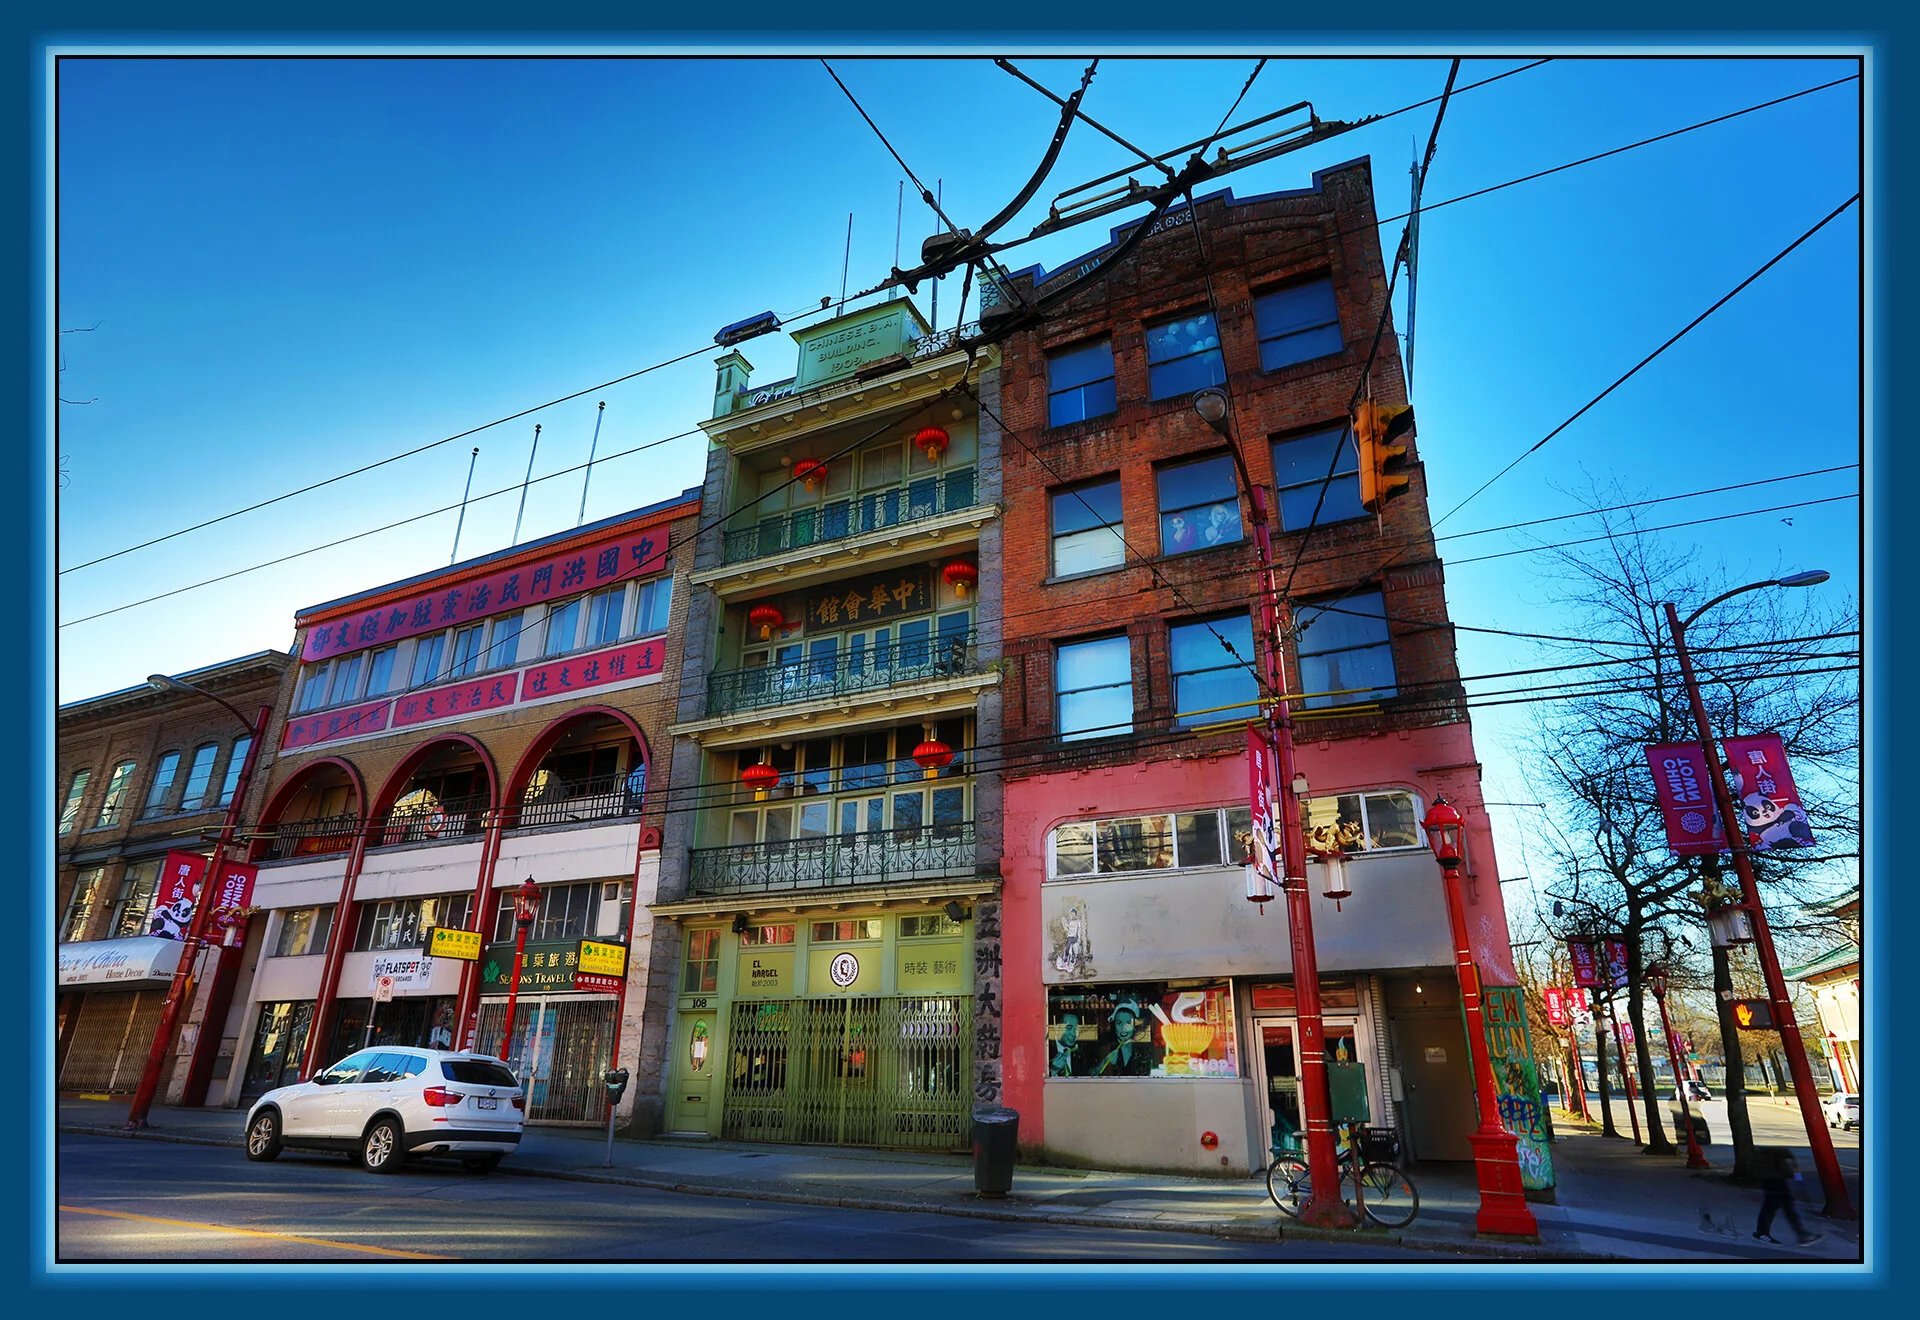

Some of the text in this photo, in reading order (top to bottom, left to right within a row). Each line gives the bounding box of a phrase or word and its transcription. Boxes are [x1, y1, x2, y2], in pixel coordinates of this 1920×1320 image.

[816, 579, 916, 625] 中華會館
[171, 864, 192, 899] 唐人街
[752, 960, 762, 968] EL
[904, 961, 928, 975] 時裝
[499, 973, 533, 985] SEAONS
[535, 972, 566, 984] TRAVEL
[692, 998, 708, 1008] 108
[1483, 991, 1522, 1024] EW
[1486, 1025, 1530, 1060] UN
